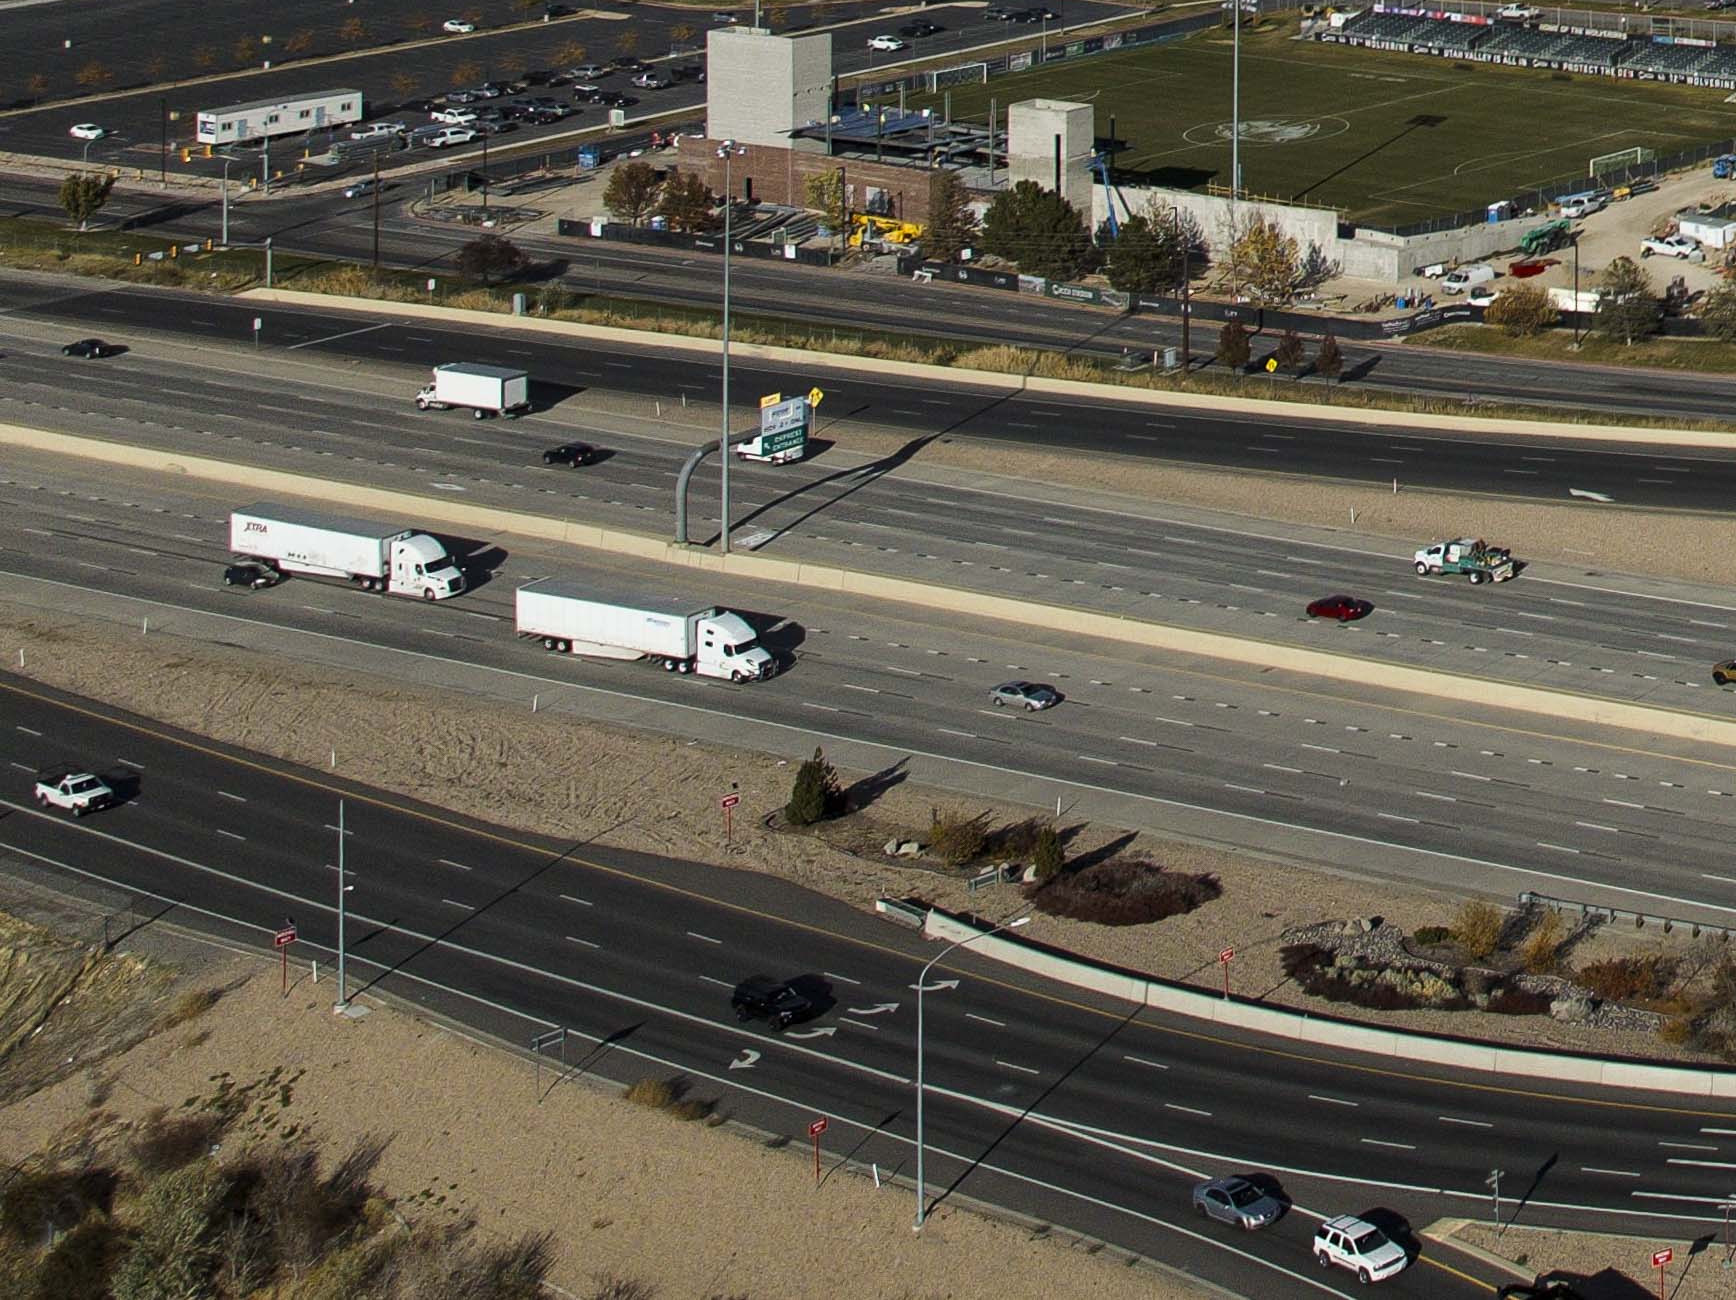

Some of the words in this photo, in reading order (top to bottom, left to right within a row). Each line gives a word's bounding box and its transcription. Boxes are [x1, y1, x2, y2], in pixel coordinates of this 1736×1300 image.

[1365, 39, 1409, 52] WOLVERINE
[1443, 49, 1463, 59] UTAH
[1464, 51, 1492, 63] VALLEY
[1493, 54, 1501, 64] IS
[1503, 55, 1517, 66] ALL
[1518, 57, 1527, 67] IN
[1562, 62, 1598, 75] PROTECT
[1601, 65, 1616, 77] THE
[1686, 76, 1736, 90] WOLVERINE
[243, 522, 268, 533] XTRA
